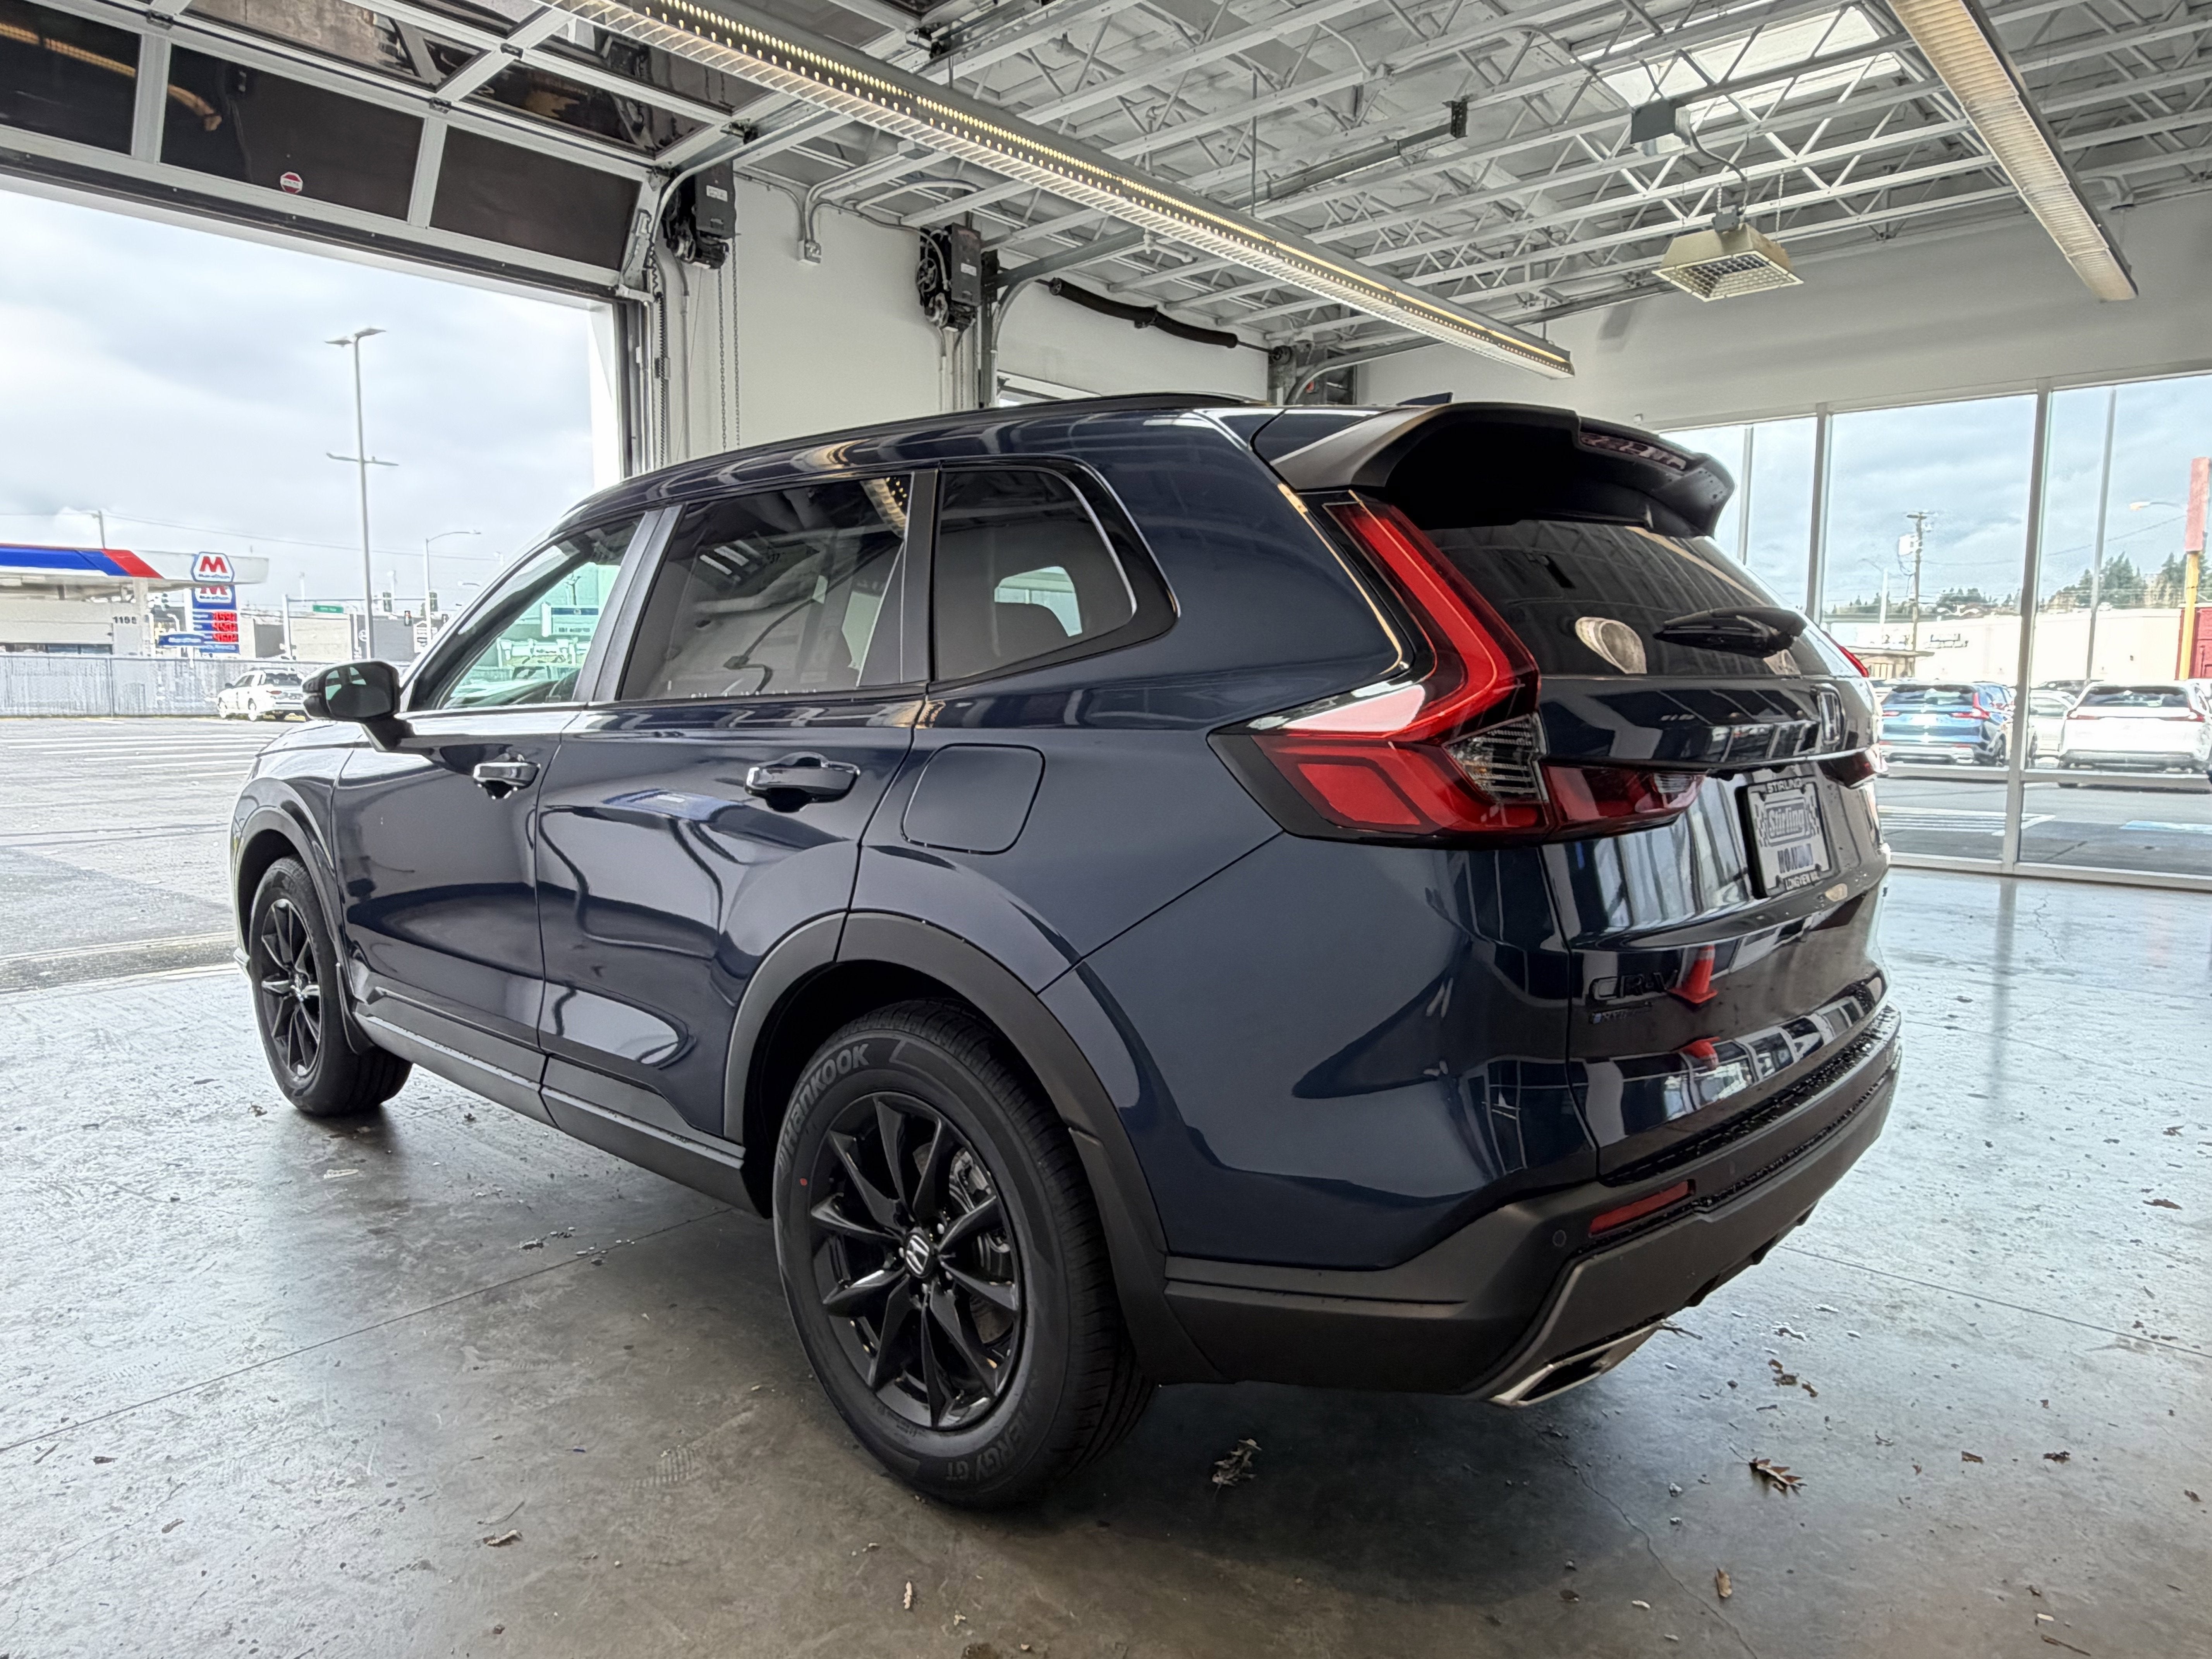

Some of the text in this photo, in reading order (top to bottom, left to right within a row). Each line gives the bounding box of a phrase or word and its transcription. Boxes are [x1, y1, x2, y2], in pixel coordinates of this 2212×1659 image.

[1766, 777, 1802, 793] STIRLING
[1768, 807, 1812, 837] Stirling
[1589, 969, 1679, 1001] CR-V
